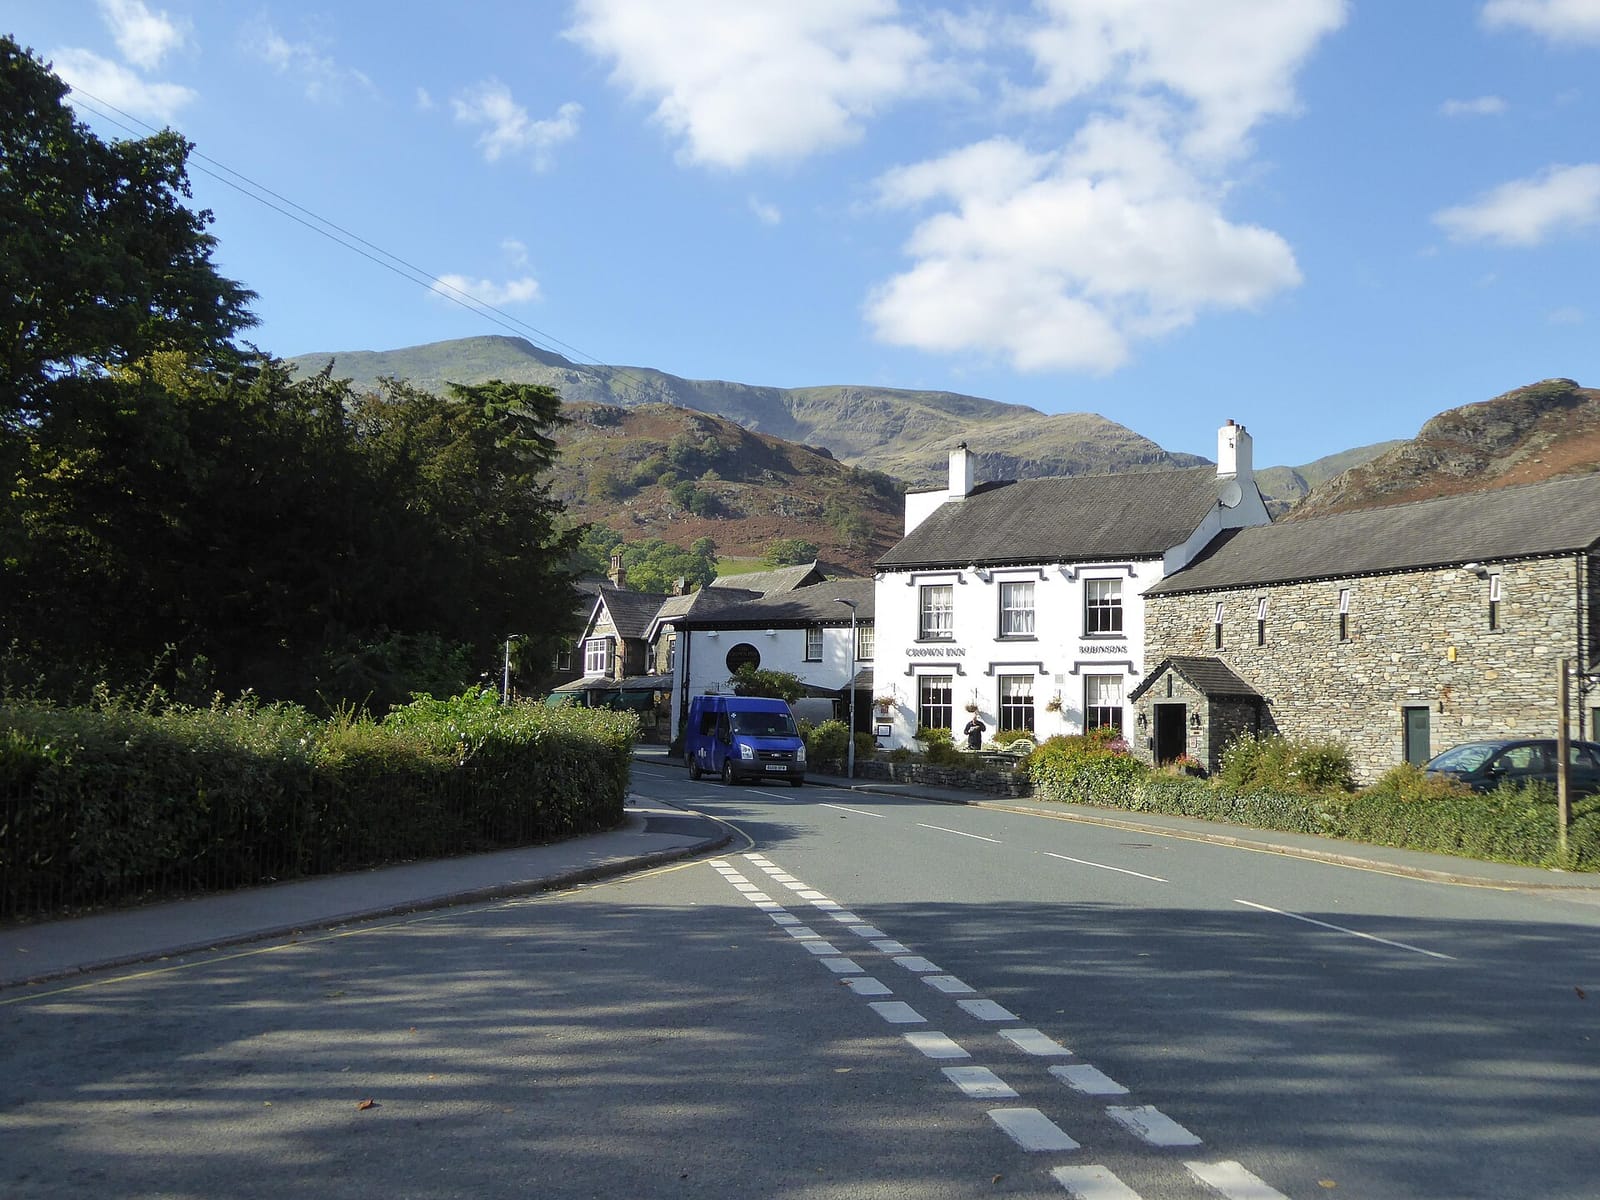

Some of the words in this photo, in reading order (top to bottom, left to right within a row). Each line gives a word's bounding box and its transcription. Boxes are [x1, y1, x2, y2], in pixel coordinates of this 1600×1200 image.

[905, 647, 944, 657] CROWN
[946, 647, 966, 657] INN
[1079, 645, 1128, 654] ROBINSONS
